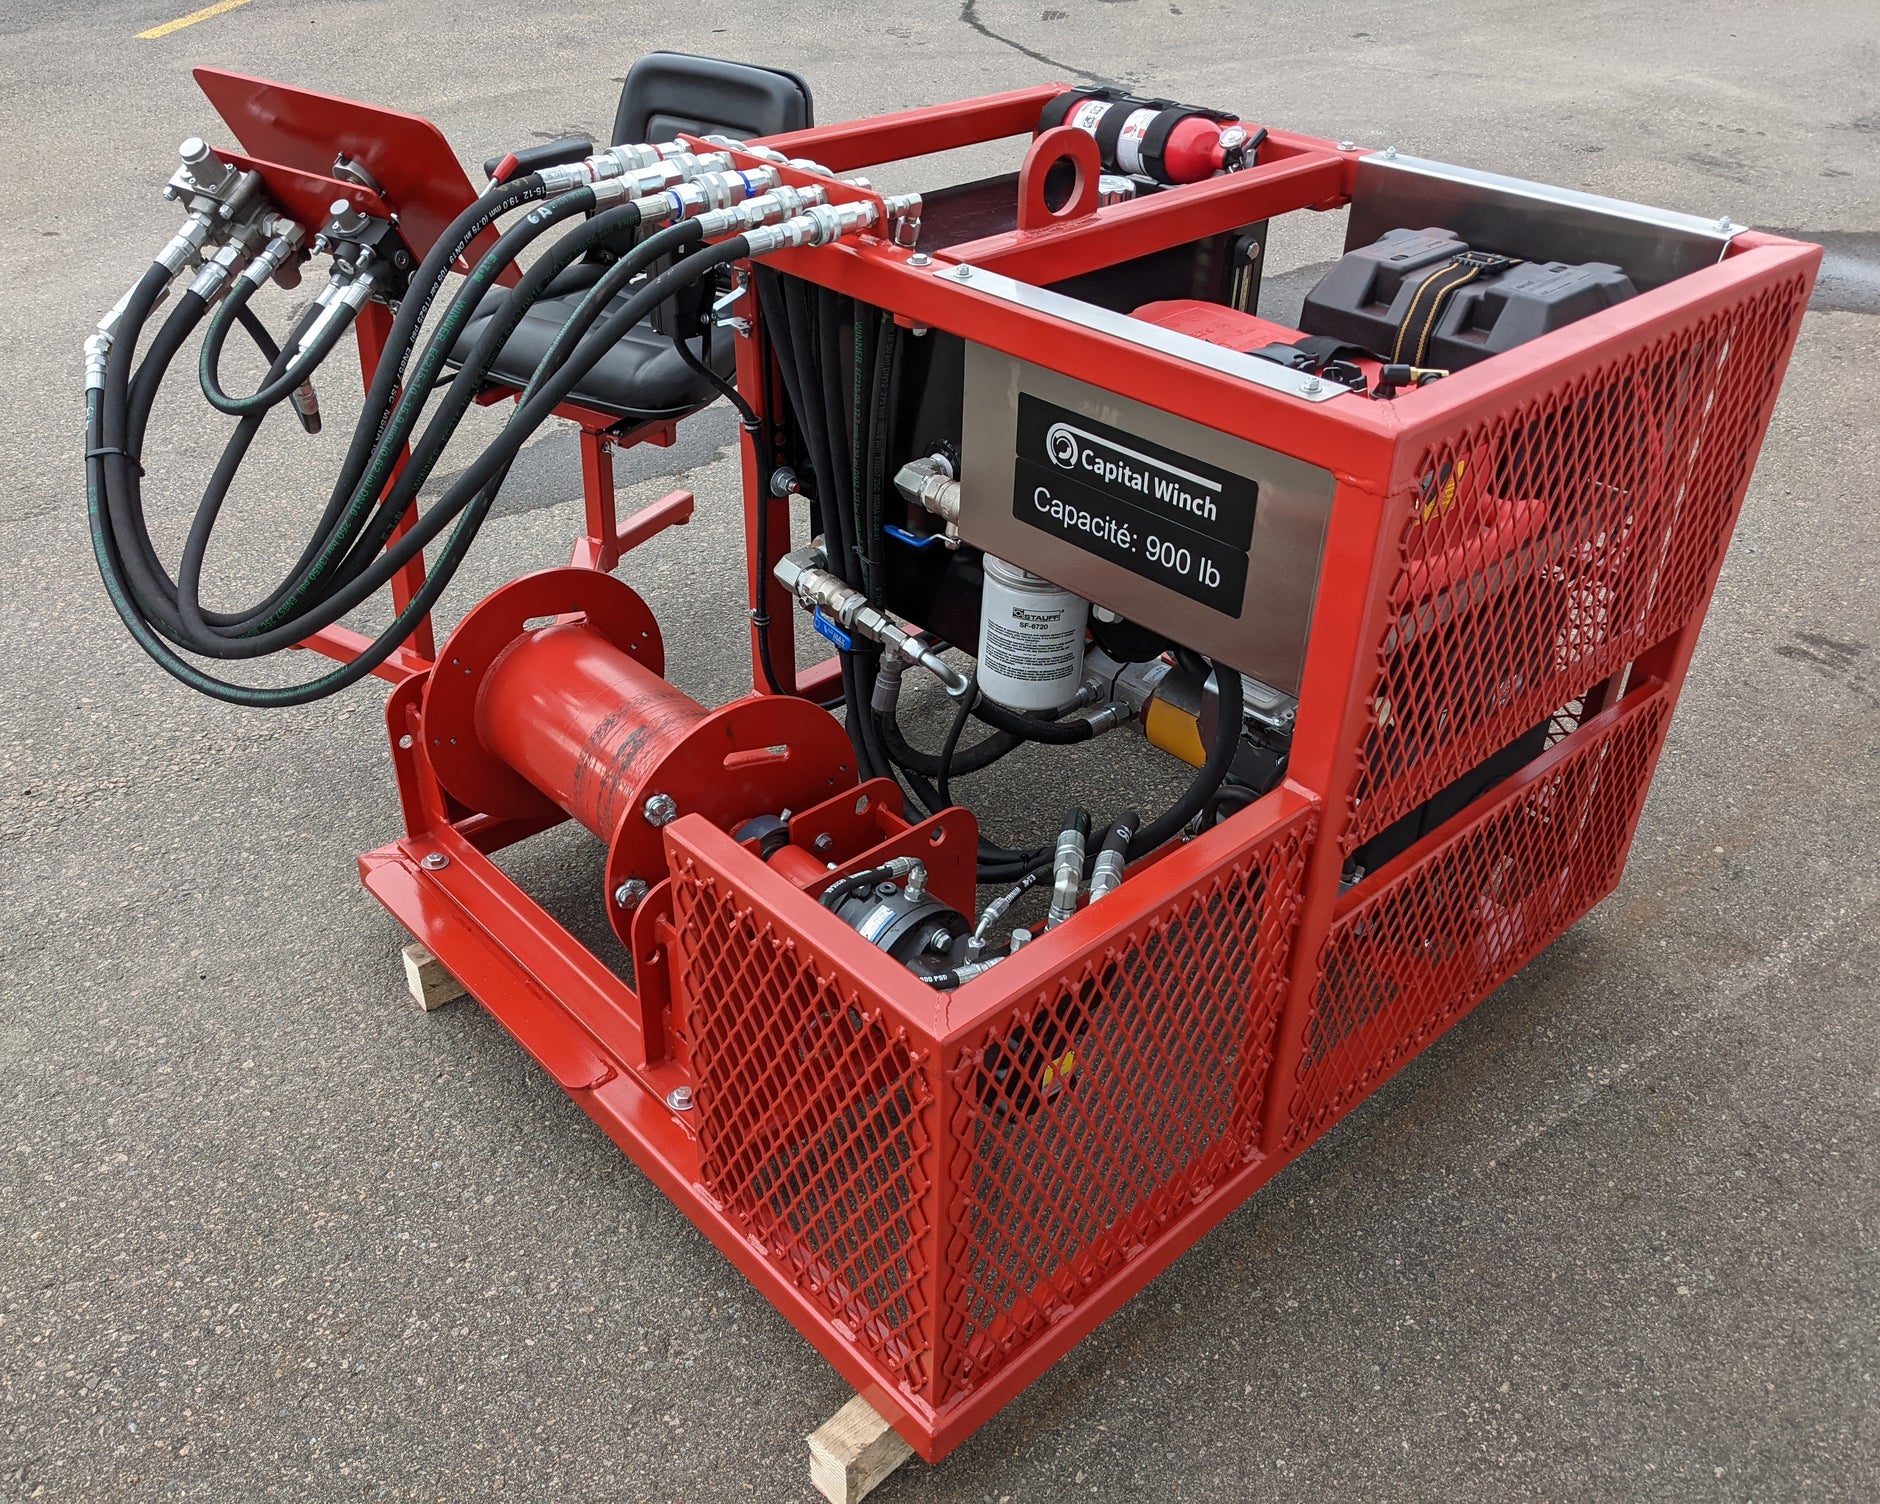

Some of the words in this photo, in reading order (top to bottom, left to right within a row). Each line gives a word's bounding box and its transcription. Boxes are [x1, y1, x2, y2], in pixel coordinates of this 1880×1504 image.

[436, 298, 466, 342] WINNER
[412, 448, 441, 491] WINNER
[1081, 448, 1150, 496] Capital
[1154, 475, 1218, 522] Winch
[93, 530, 111, 570] WINNER
[1033, 486, 1137, 553] Capacité:
[1145, 535, 1191, 575] 900
[1198, 557, 1221, 589] lb
[1019, 622, 1049, 630] SF-6720
